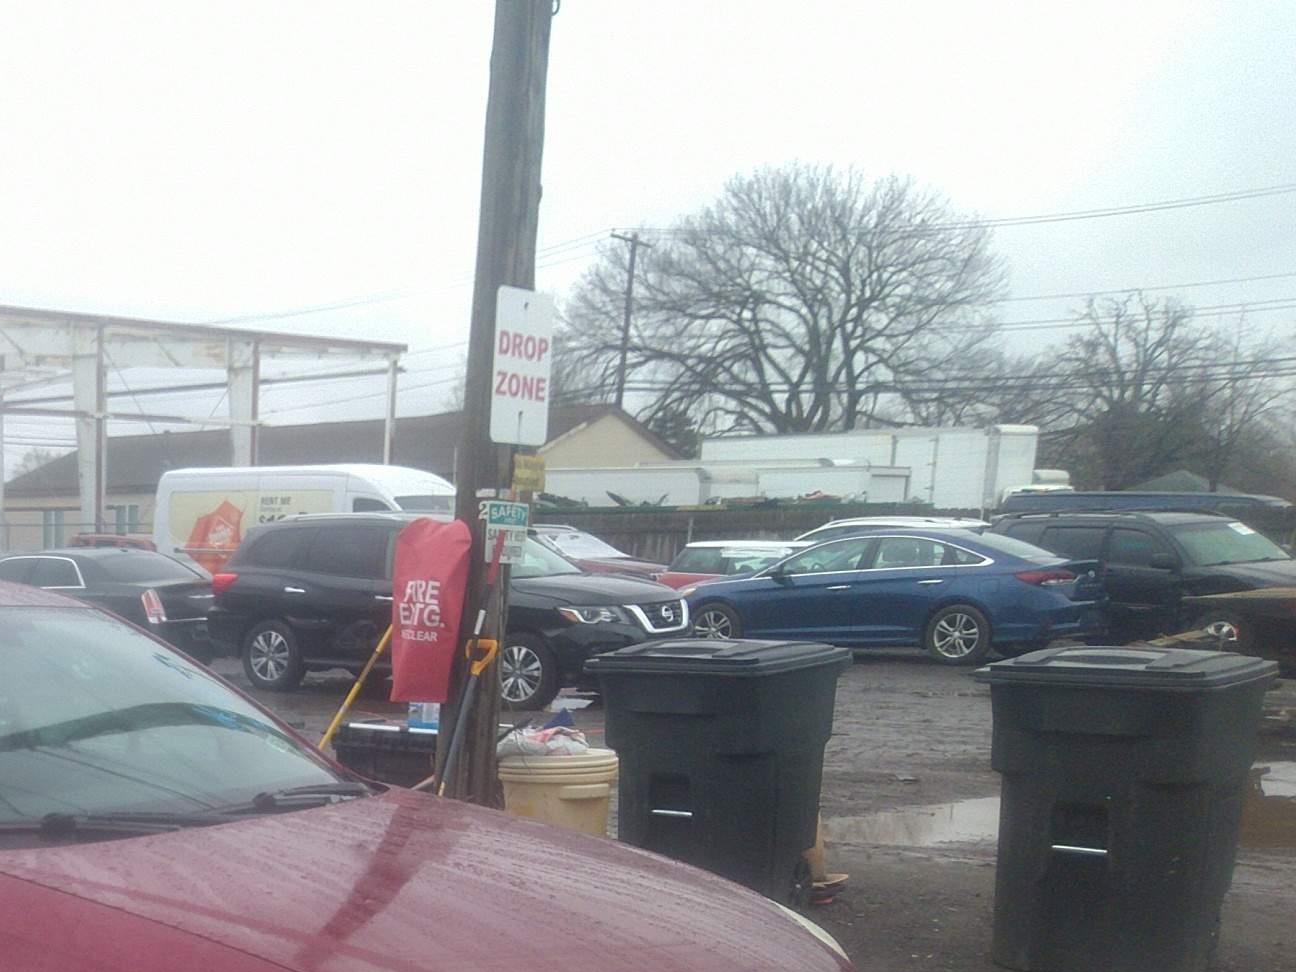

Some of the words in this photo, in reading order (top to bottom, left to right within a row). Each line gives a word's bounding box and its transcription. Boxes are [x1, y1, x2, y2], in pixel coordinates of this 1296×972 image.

[499, 330, 549, 361] DROP
[496, 371, 546, 401] ZONE
[491, 504, 526, 520] SAFETY
